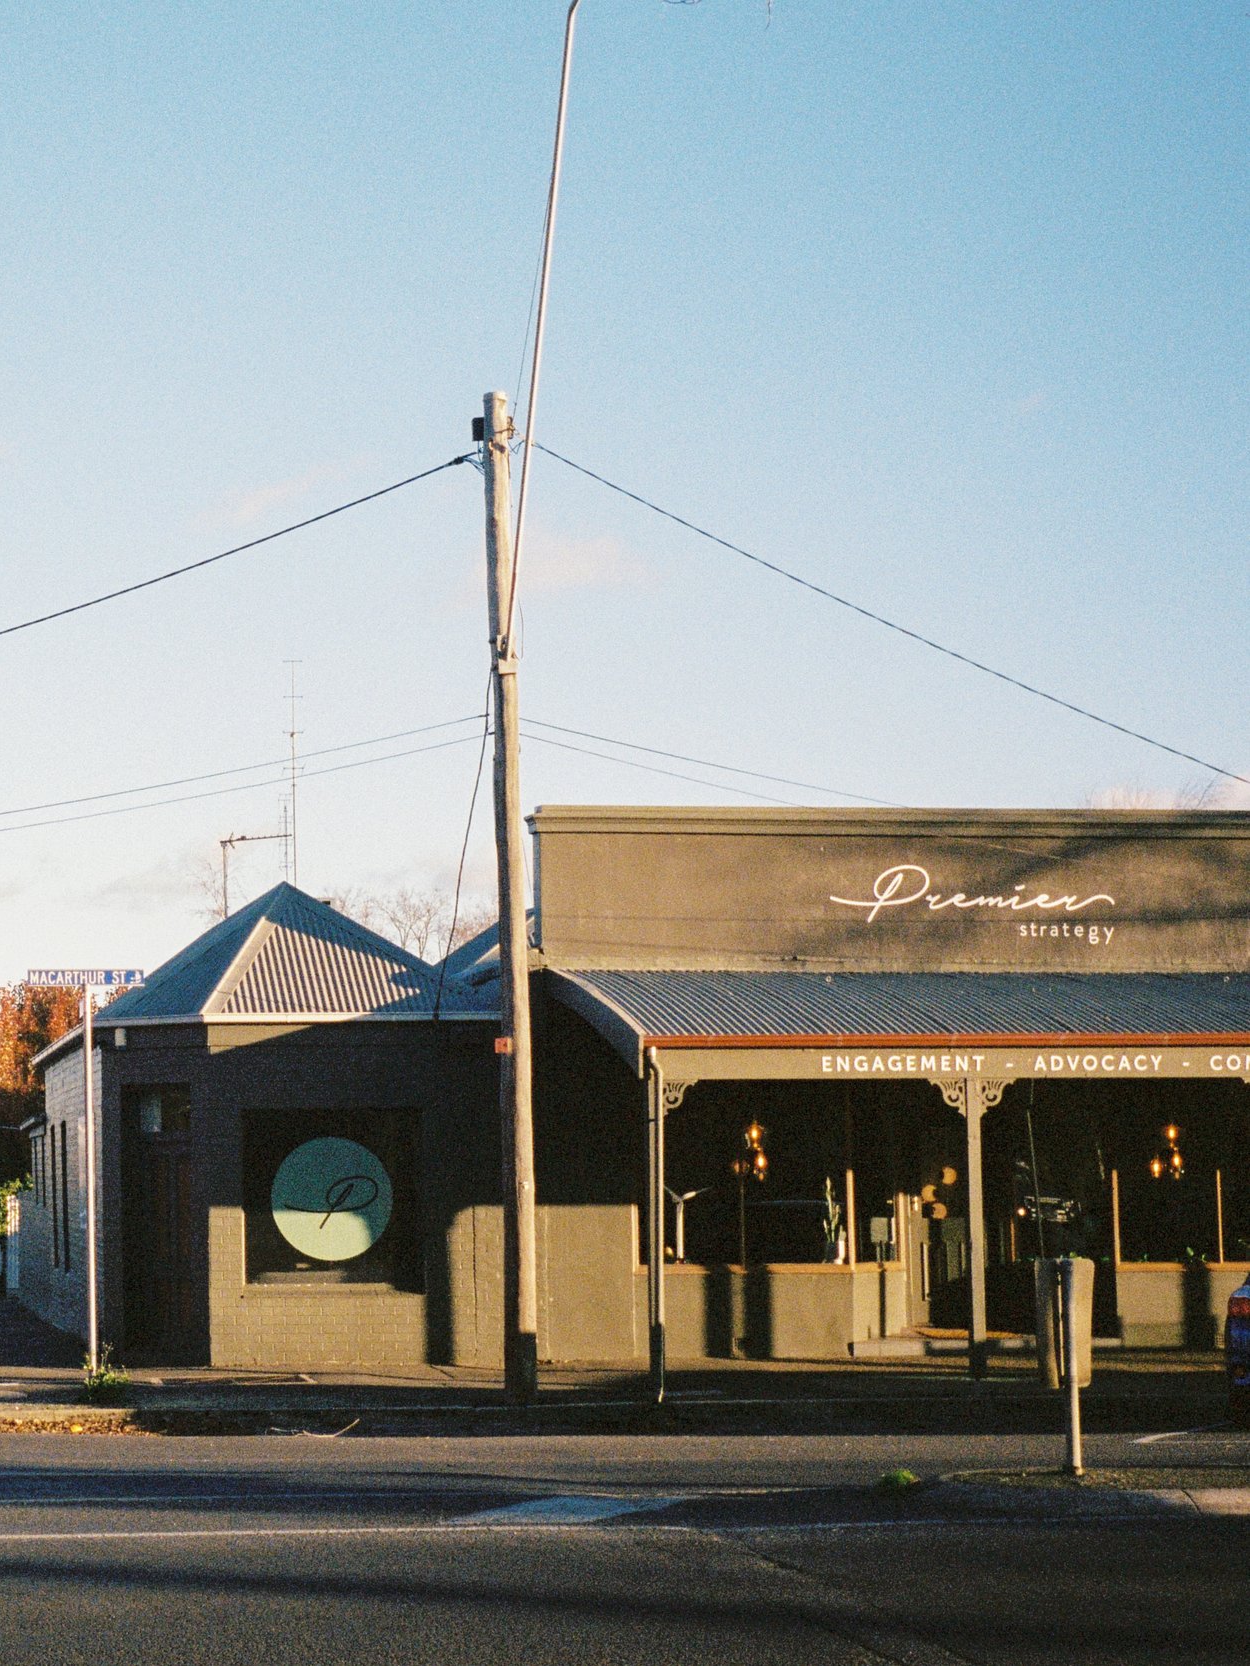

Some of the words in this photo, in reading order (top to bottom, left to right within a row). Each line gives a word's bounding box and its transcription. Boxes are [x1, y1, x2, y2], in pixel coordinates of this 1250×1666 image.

[829, 864, 1116, 923] Premier
[1019, 923, 1115, 944] strategy
[30, 970, 106, 985] MACARTHUR
[111, 971, 127, 985] ST
[821, 1055, 986, 1072] ENGAGEMENT
[1033, 1054, 1163, 1072] ADVOCACY
[1209, 1054, 1250, 1072] CO
